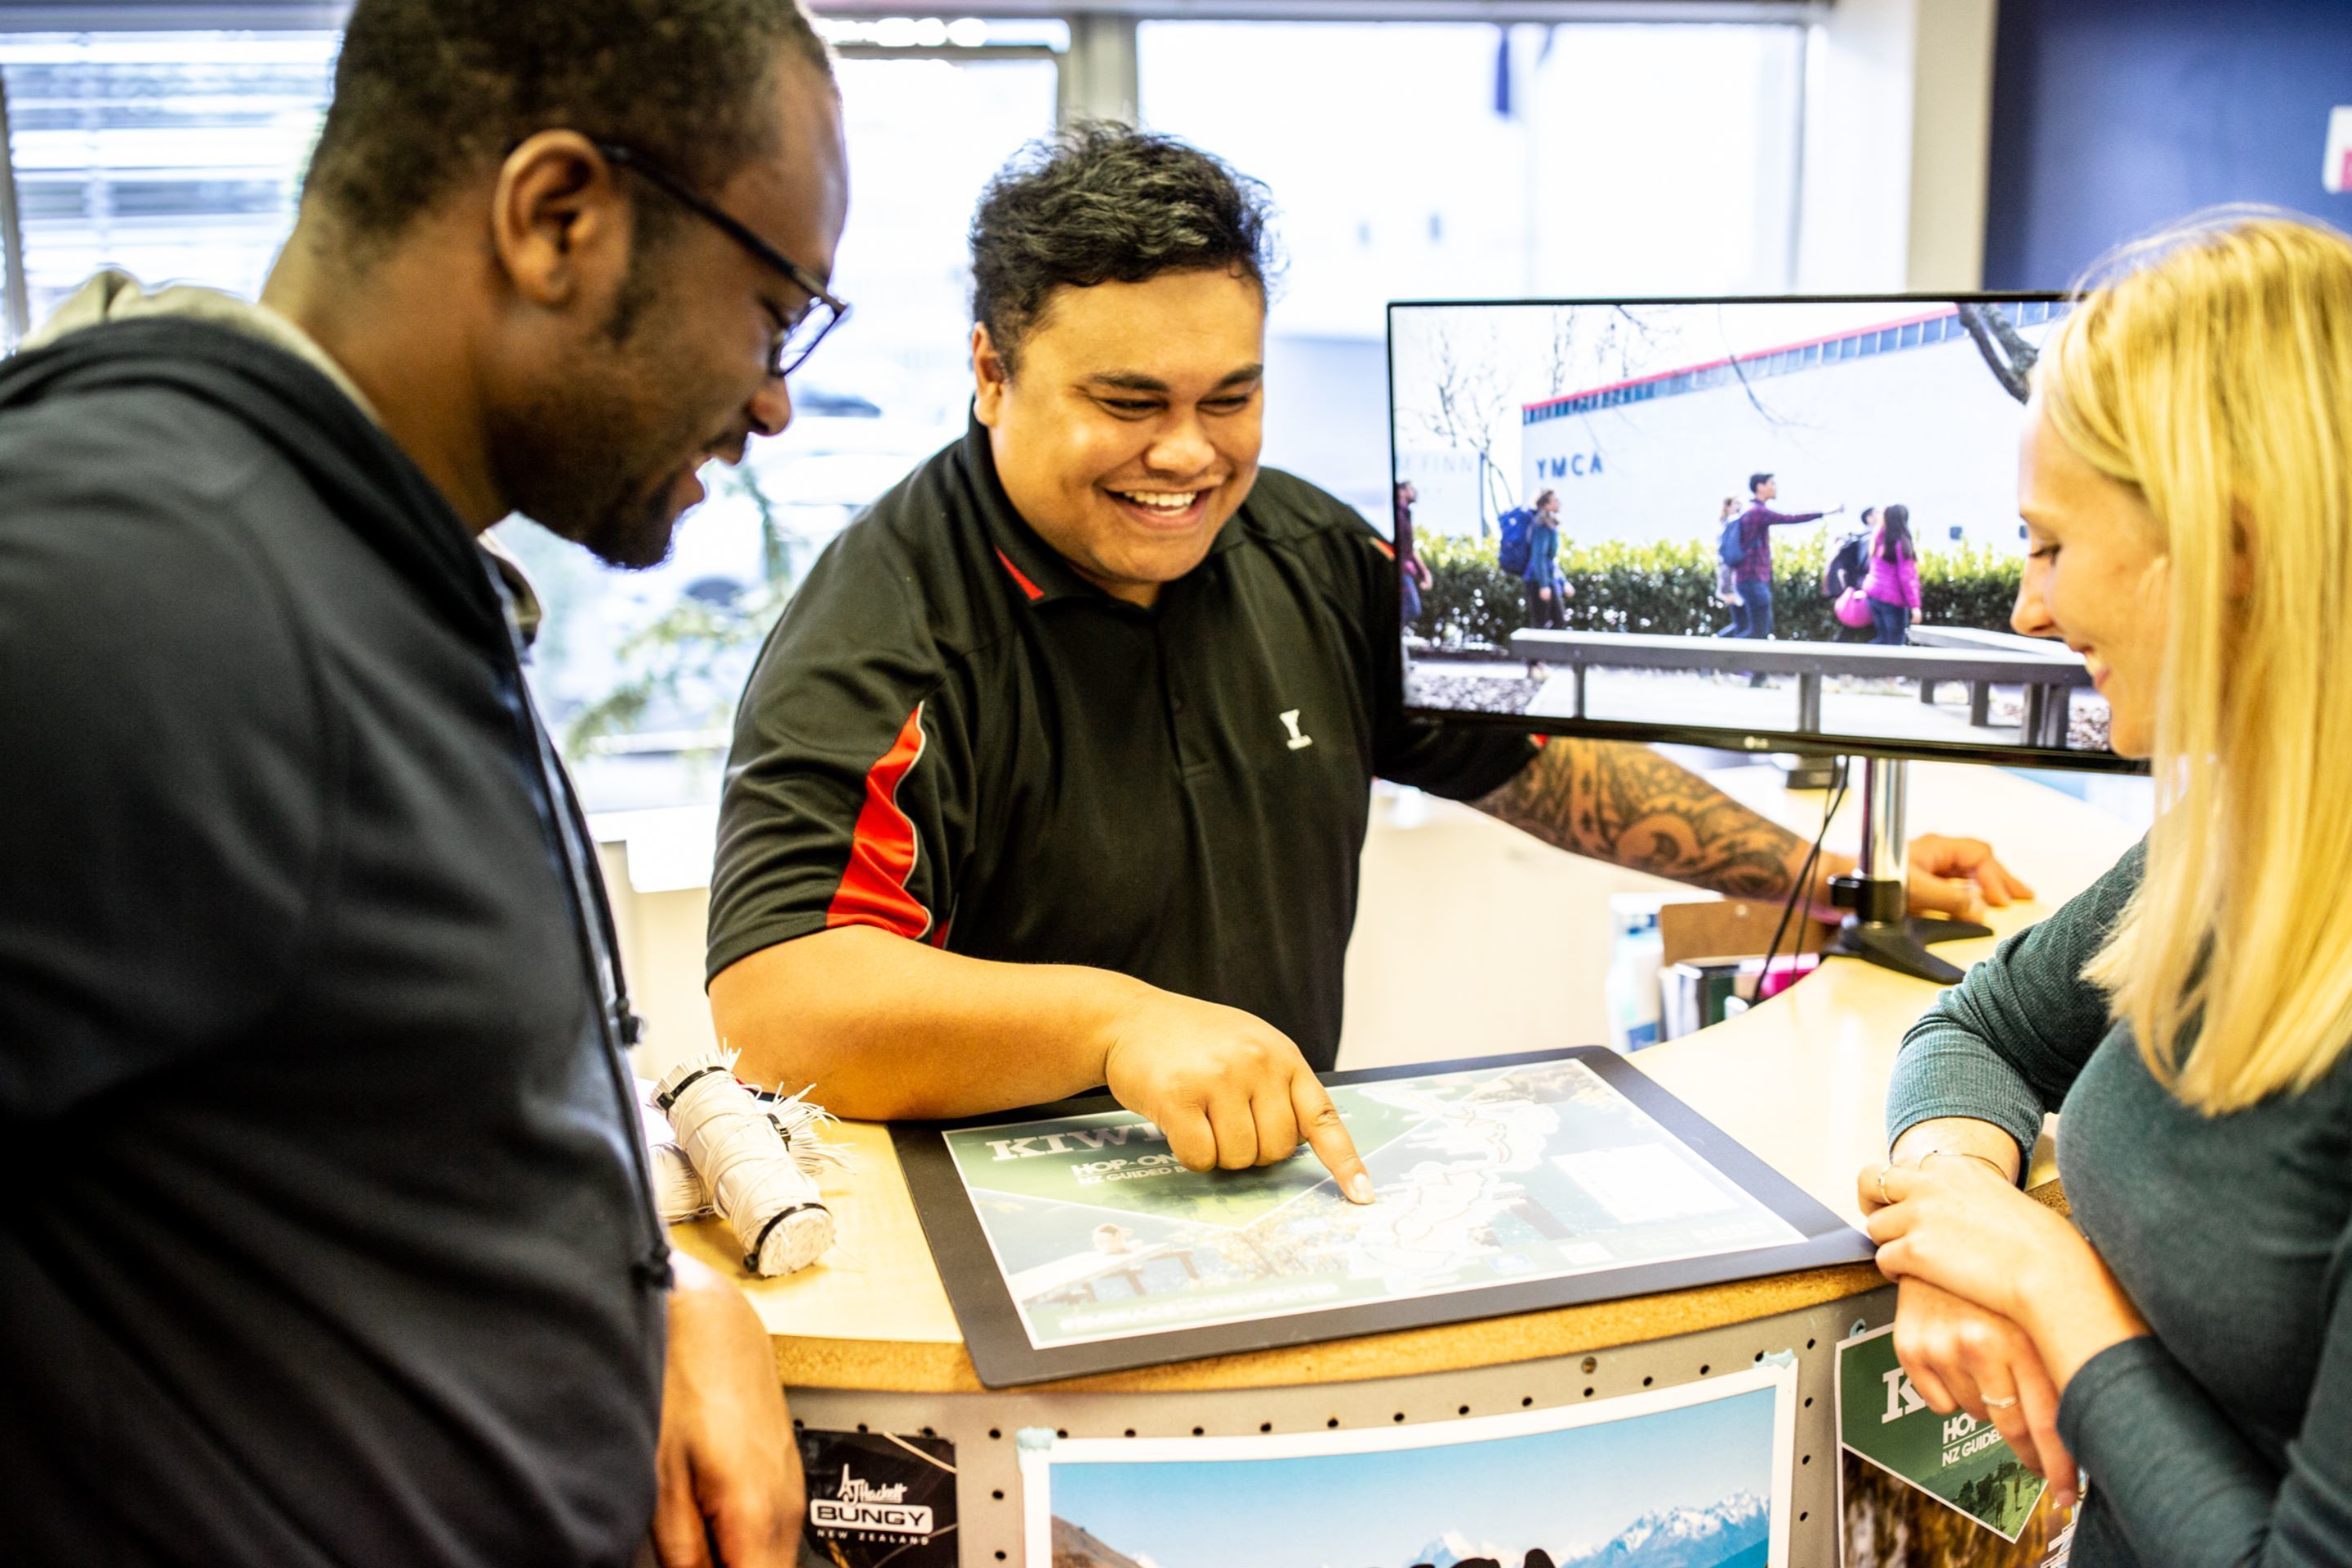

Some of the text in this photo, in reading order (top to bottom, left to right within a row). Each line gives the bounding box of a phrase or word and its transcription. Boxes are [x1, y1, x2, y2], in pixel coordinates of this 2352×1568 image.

[1535, 453, 1603, 479] YMCA
[1106, 1167, 1172, 1181] GUIDED
[1942, 1446, 1960, 1468] NZ
[817, 1506, 925, 1527] BUNGY
[817, 1529, 929, 1545] NEW ZEALAND
